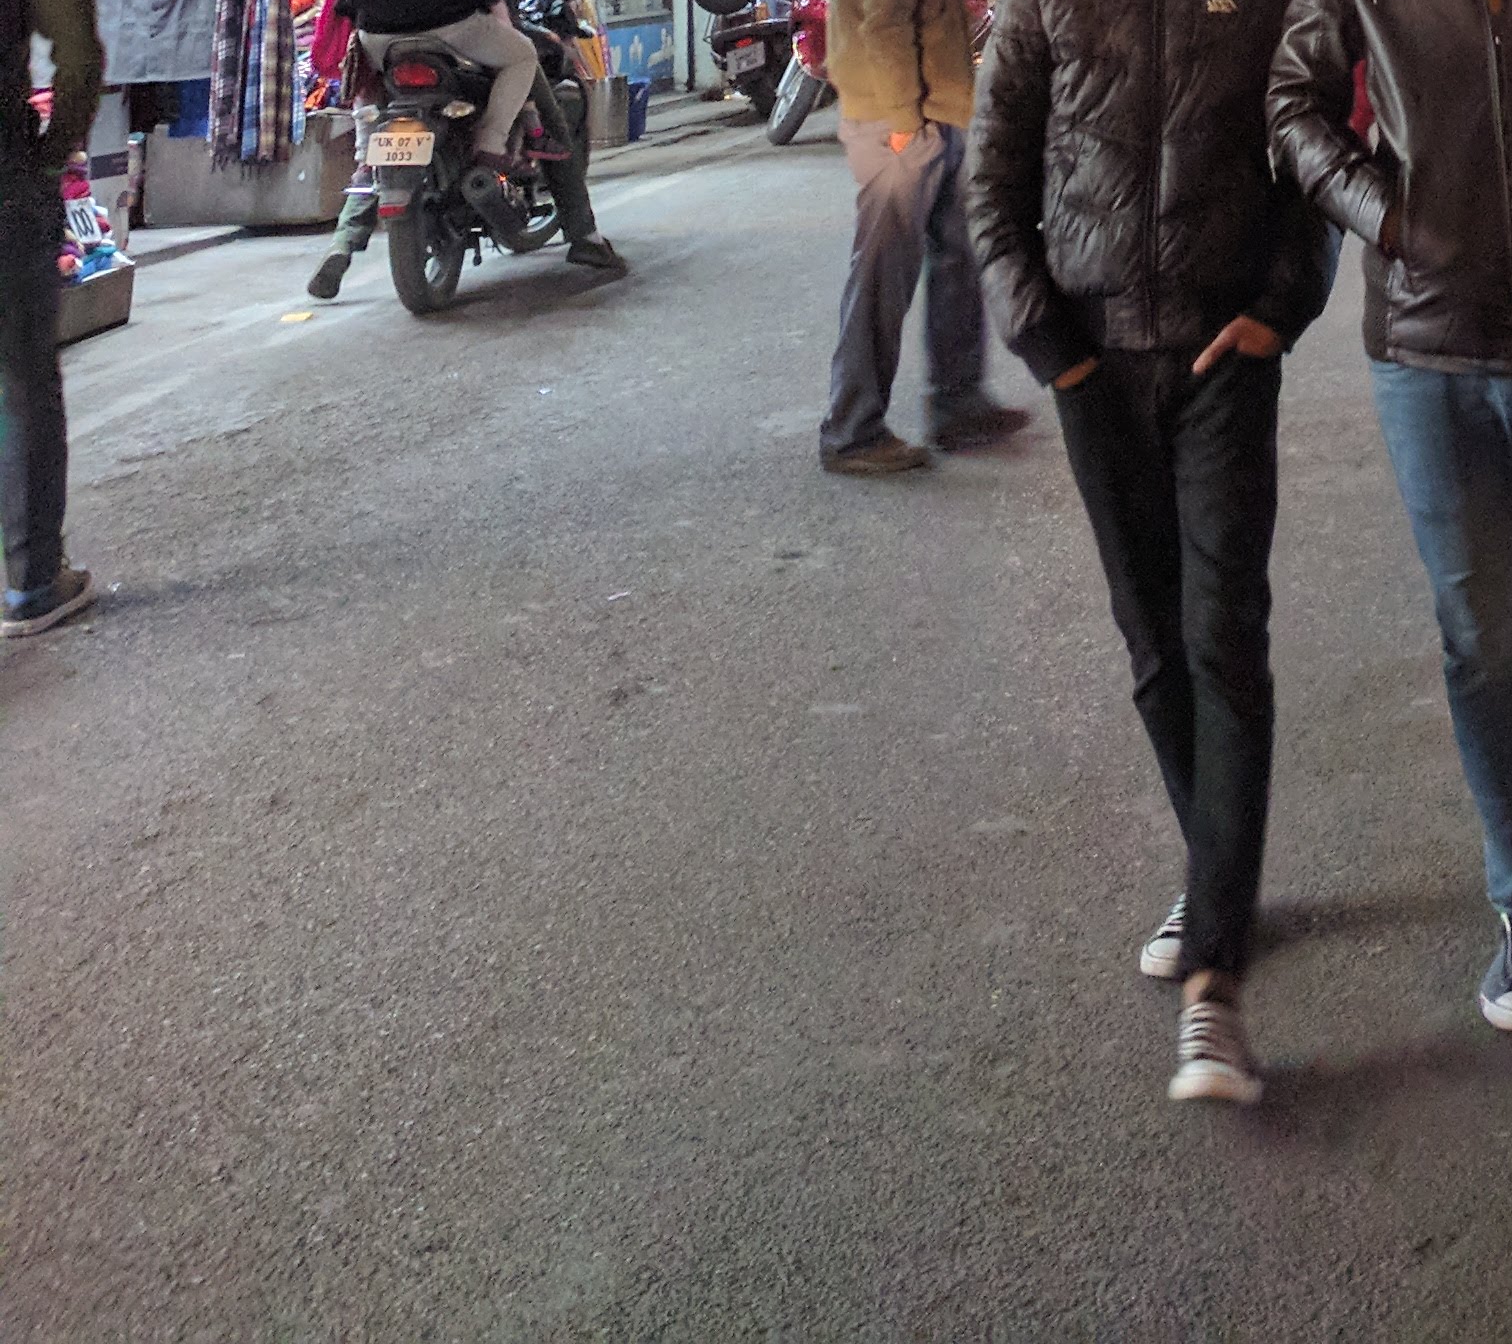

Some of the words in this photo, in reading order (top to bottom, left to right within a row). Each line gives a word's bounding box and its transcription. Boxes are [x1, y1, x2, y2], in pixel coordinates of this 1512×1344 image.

[378, 137, 393, 147] UK
[398, 137, 411, 147] 07
[385, 151, 412, 162] 1033
